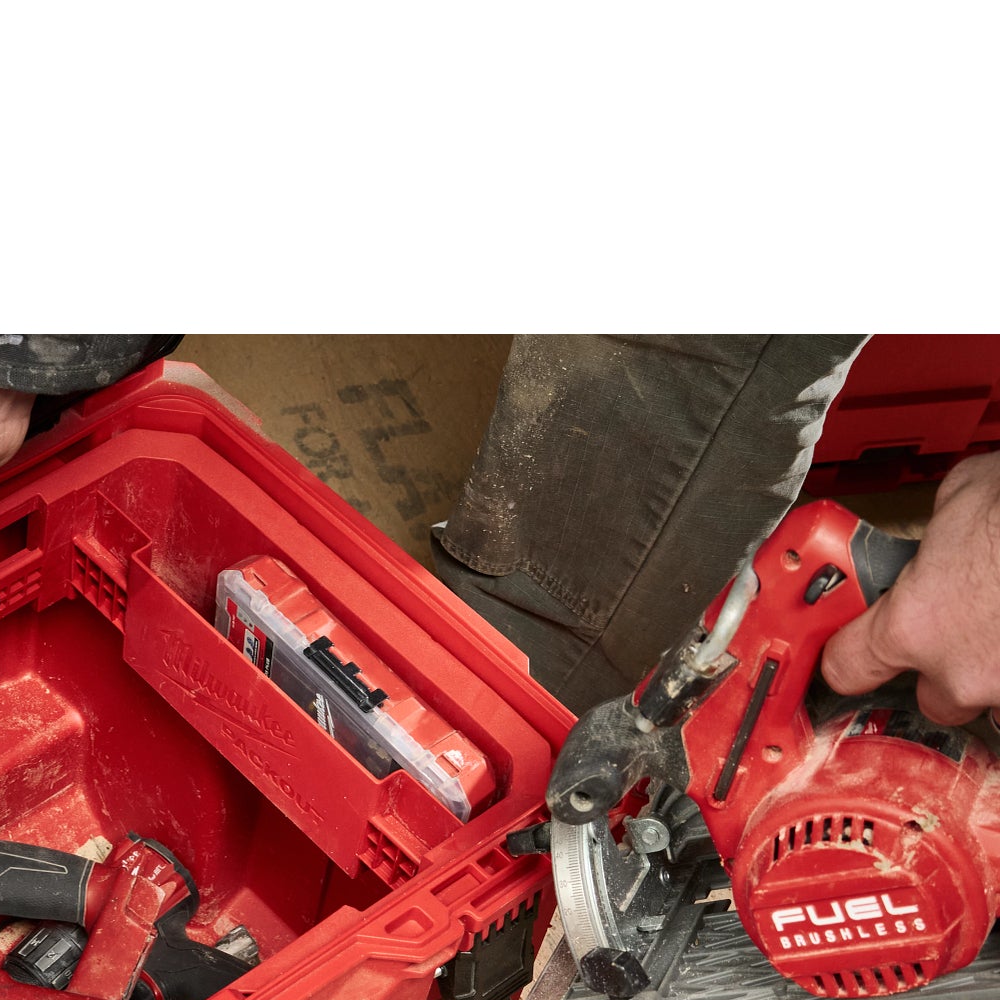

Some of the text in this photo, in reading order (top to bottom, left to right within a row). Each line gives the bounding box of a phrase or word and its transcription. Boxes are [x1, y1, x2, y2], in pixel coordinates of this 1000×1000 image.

[158, 628, 297, 750] Milwaukee
[220, 722, 325, 823] PACKOUT
[771, 893, 919, 932] FUEL
[780, 918, 926, 950] BRUSHLESS
